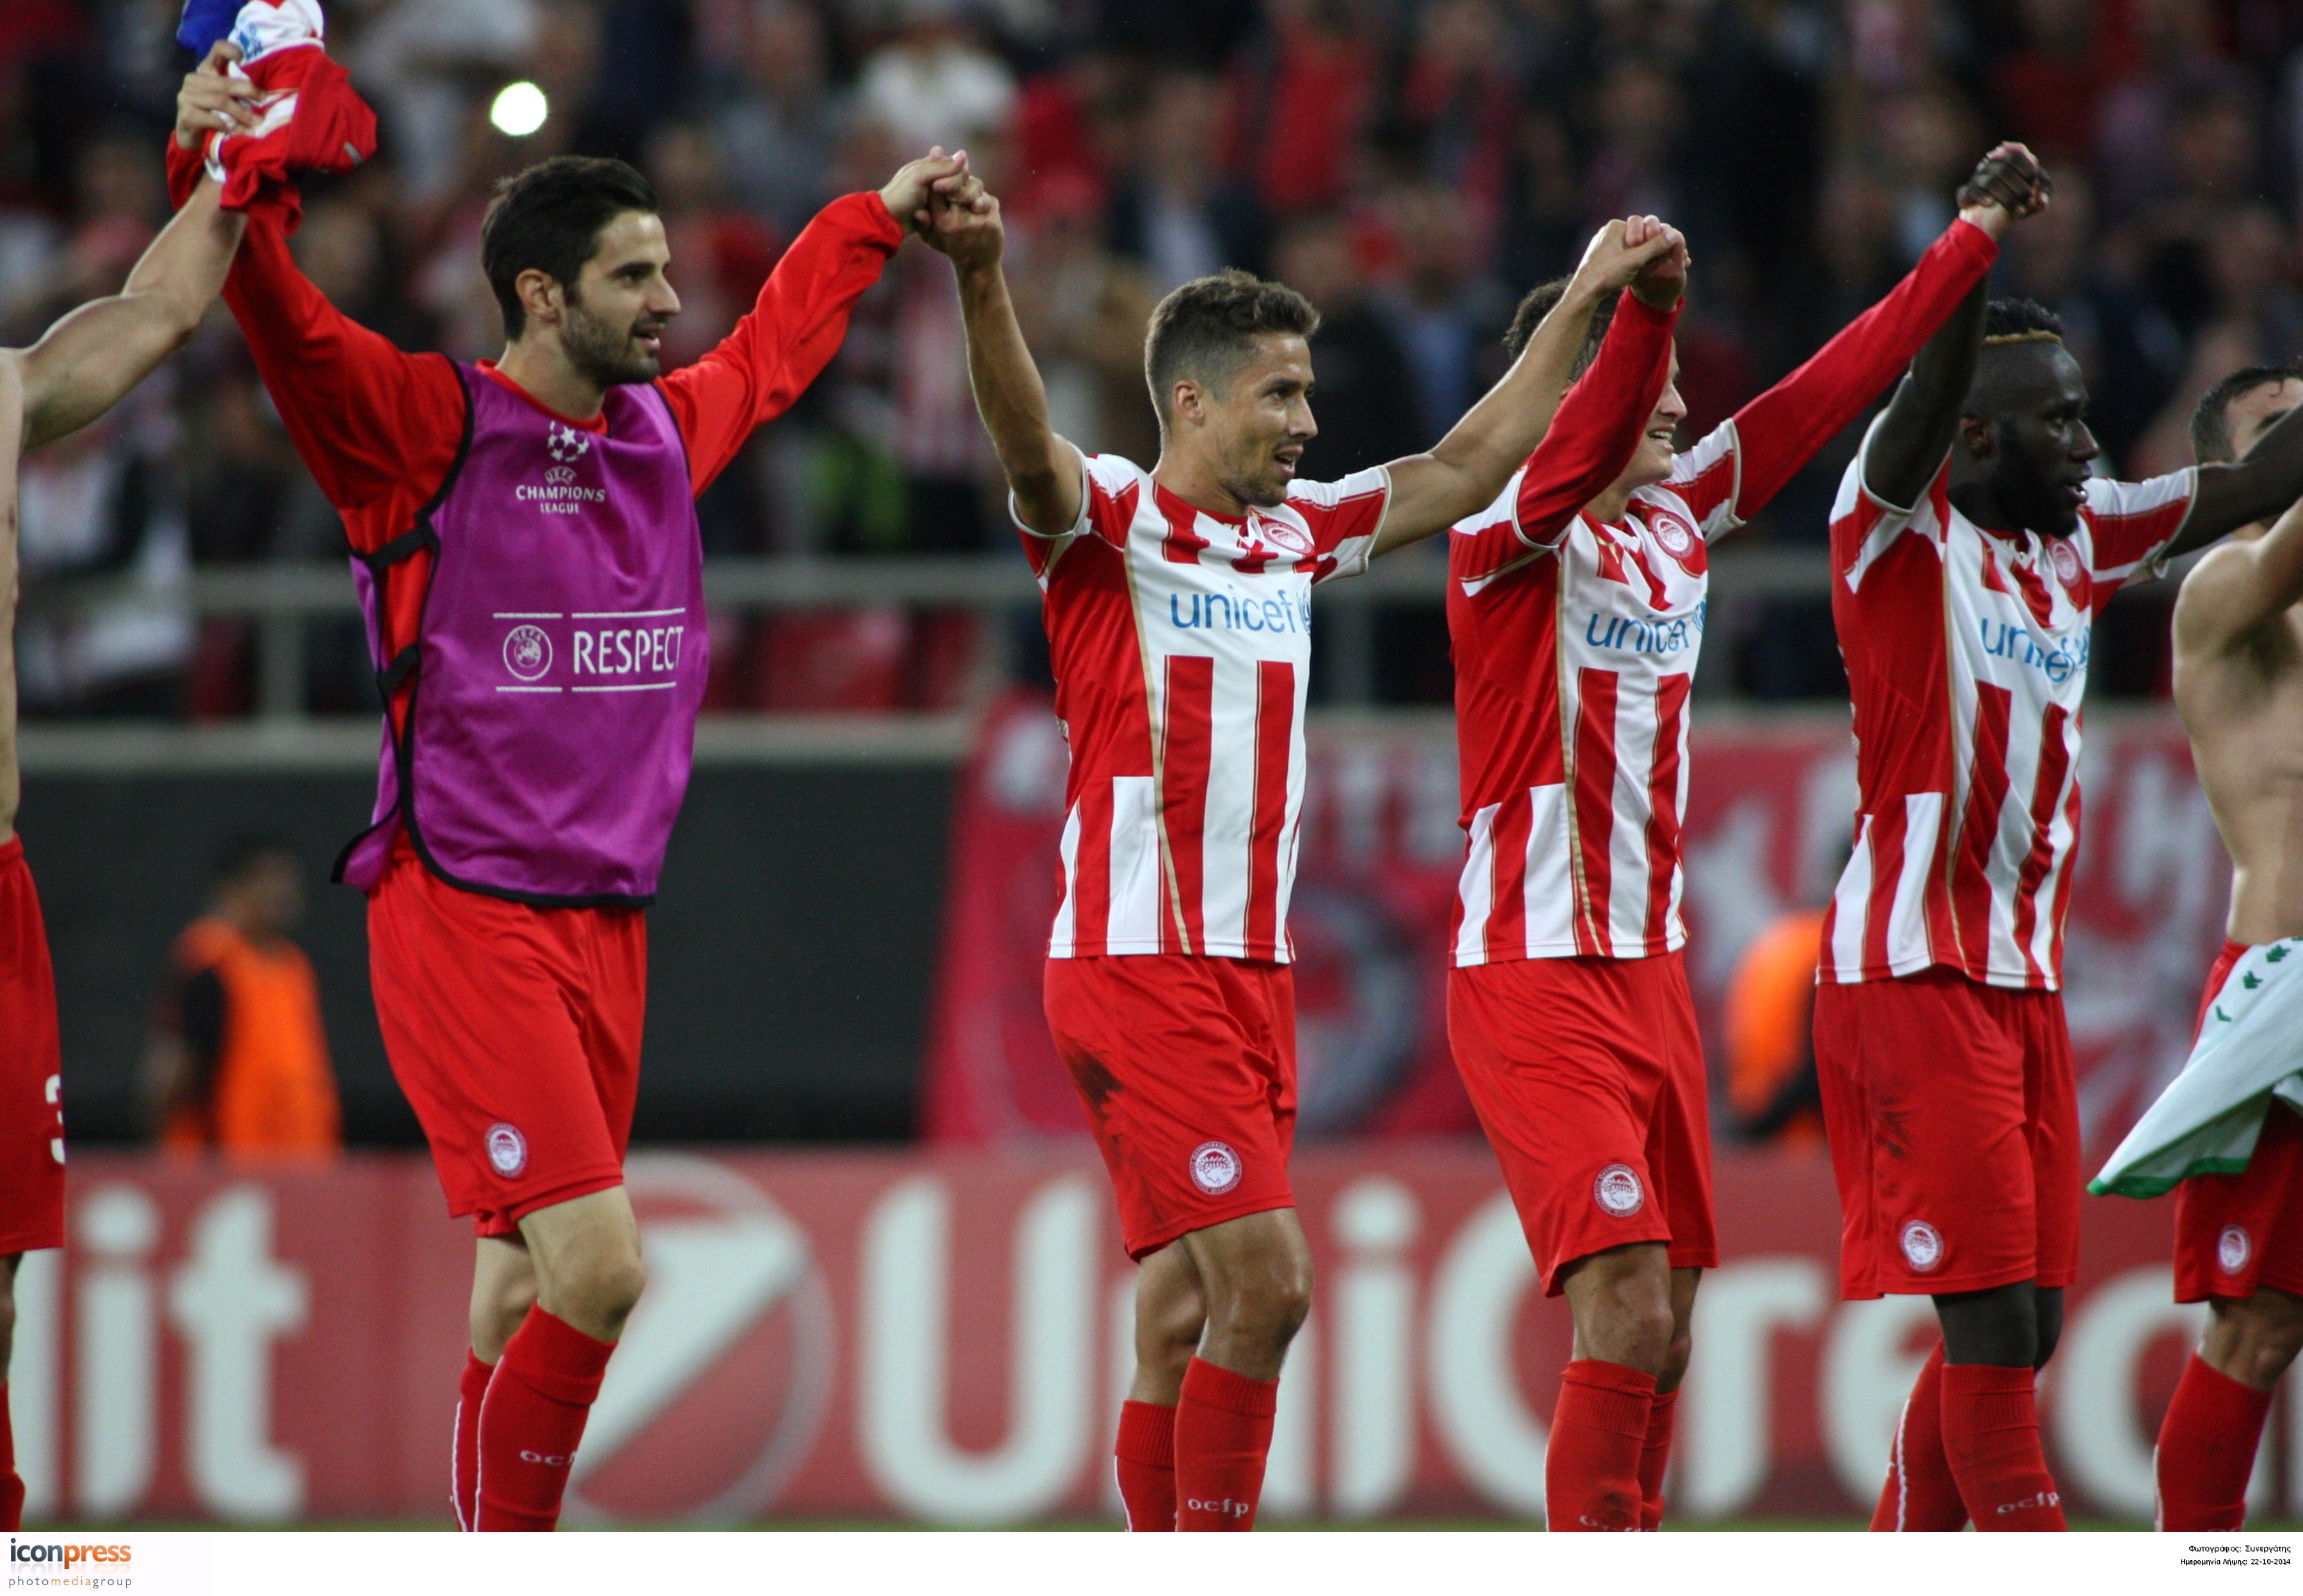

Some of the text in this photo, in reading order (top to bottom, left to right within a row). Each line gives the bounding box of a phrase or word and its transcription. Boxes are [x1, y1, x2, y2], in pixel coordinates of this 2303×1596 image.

[544, 466, 577, 485] UEFA
[516, 484, 606, 503] CHAMPIONS
[540, 502, 580, 514] LEAGUE
[1171, 583, 1296, 633] unicef
[573, 626, 684, 674] RESPECT
[1187, 1498, 1249, 1519] ocfp
